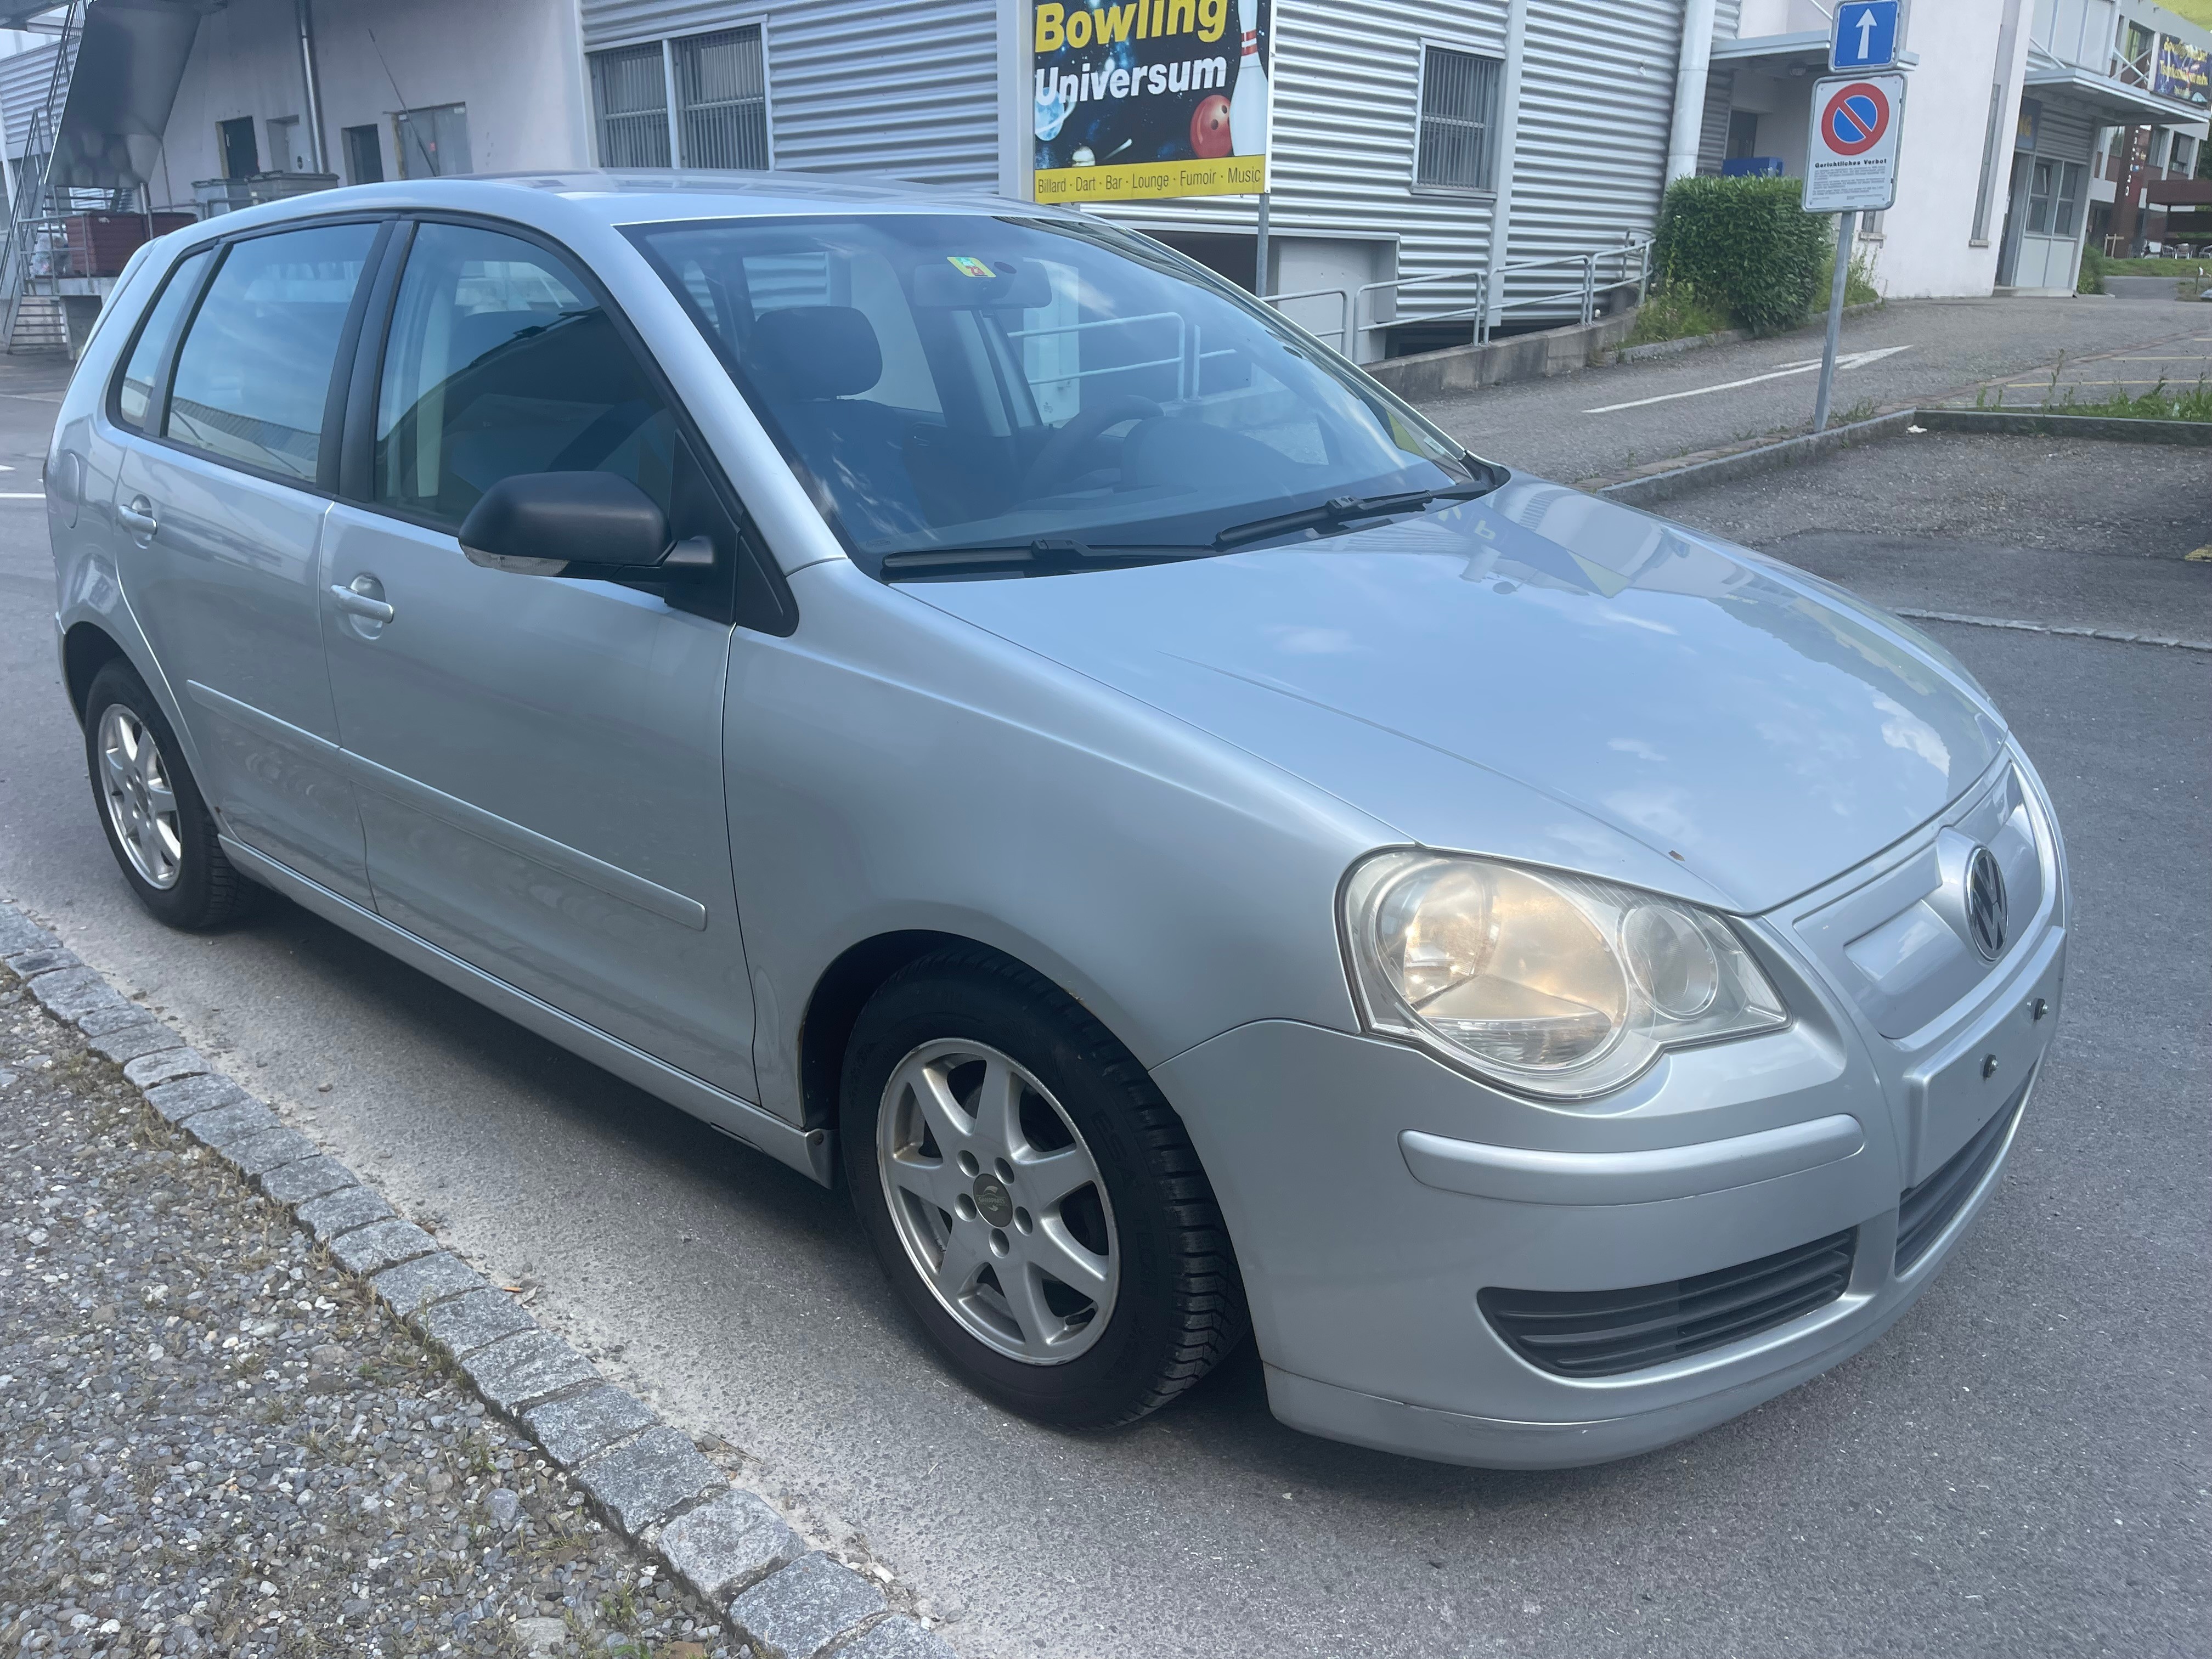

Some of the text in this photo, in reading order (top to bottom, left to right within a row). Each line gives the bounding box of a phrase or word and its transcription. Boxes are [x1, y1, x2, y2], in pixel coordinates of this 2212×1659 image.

[1035, 0, 1228, 53] Bowling
[1036, 56, 1227, 106] Universum
[1039, 166, 1261, 193] Billard Dart Bar Lounge Fumoir Music
